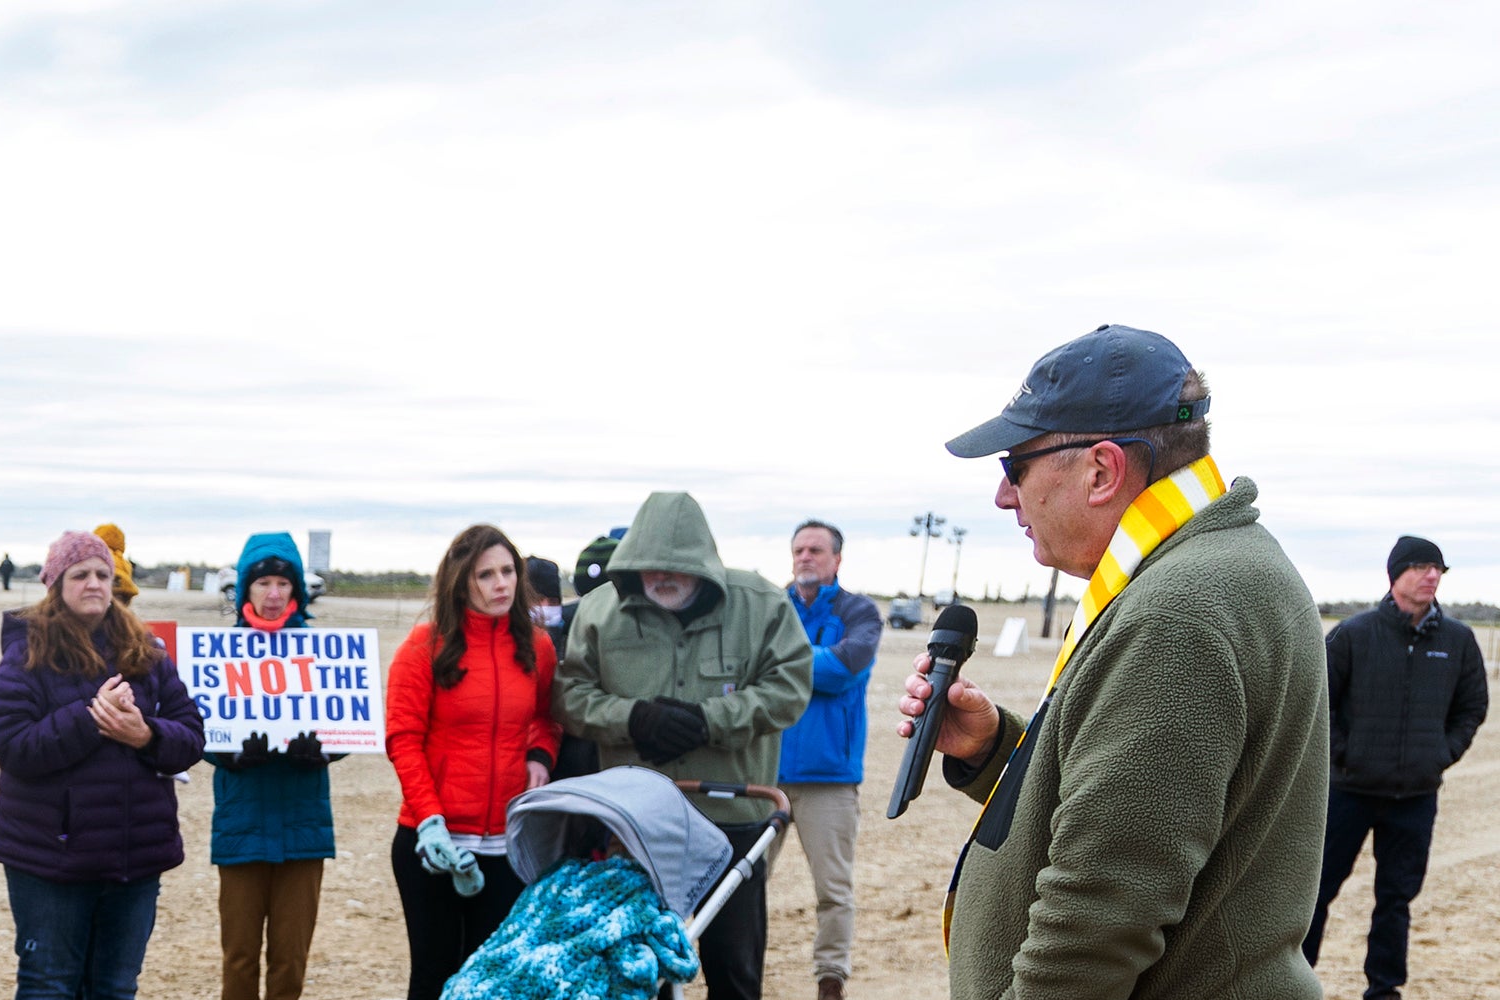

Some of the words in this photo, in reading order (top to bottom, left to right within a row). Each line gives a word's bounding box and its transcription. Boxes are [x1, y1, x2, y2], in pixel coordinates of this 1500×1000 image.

[192, 633, 366, 660] EXECUTION
[193, 665, 220, 688] IS
[224, 657, 315, 697] NOT
[316, 666, 369, 689] THE
[194, 694, 371, 721] SOLUTION
